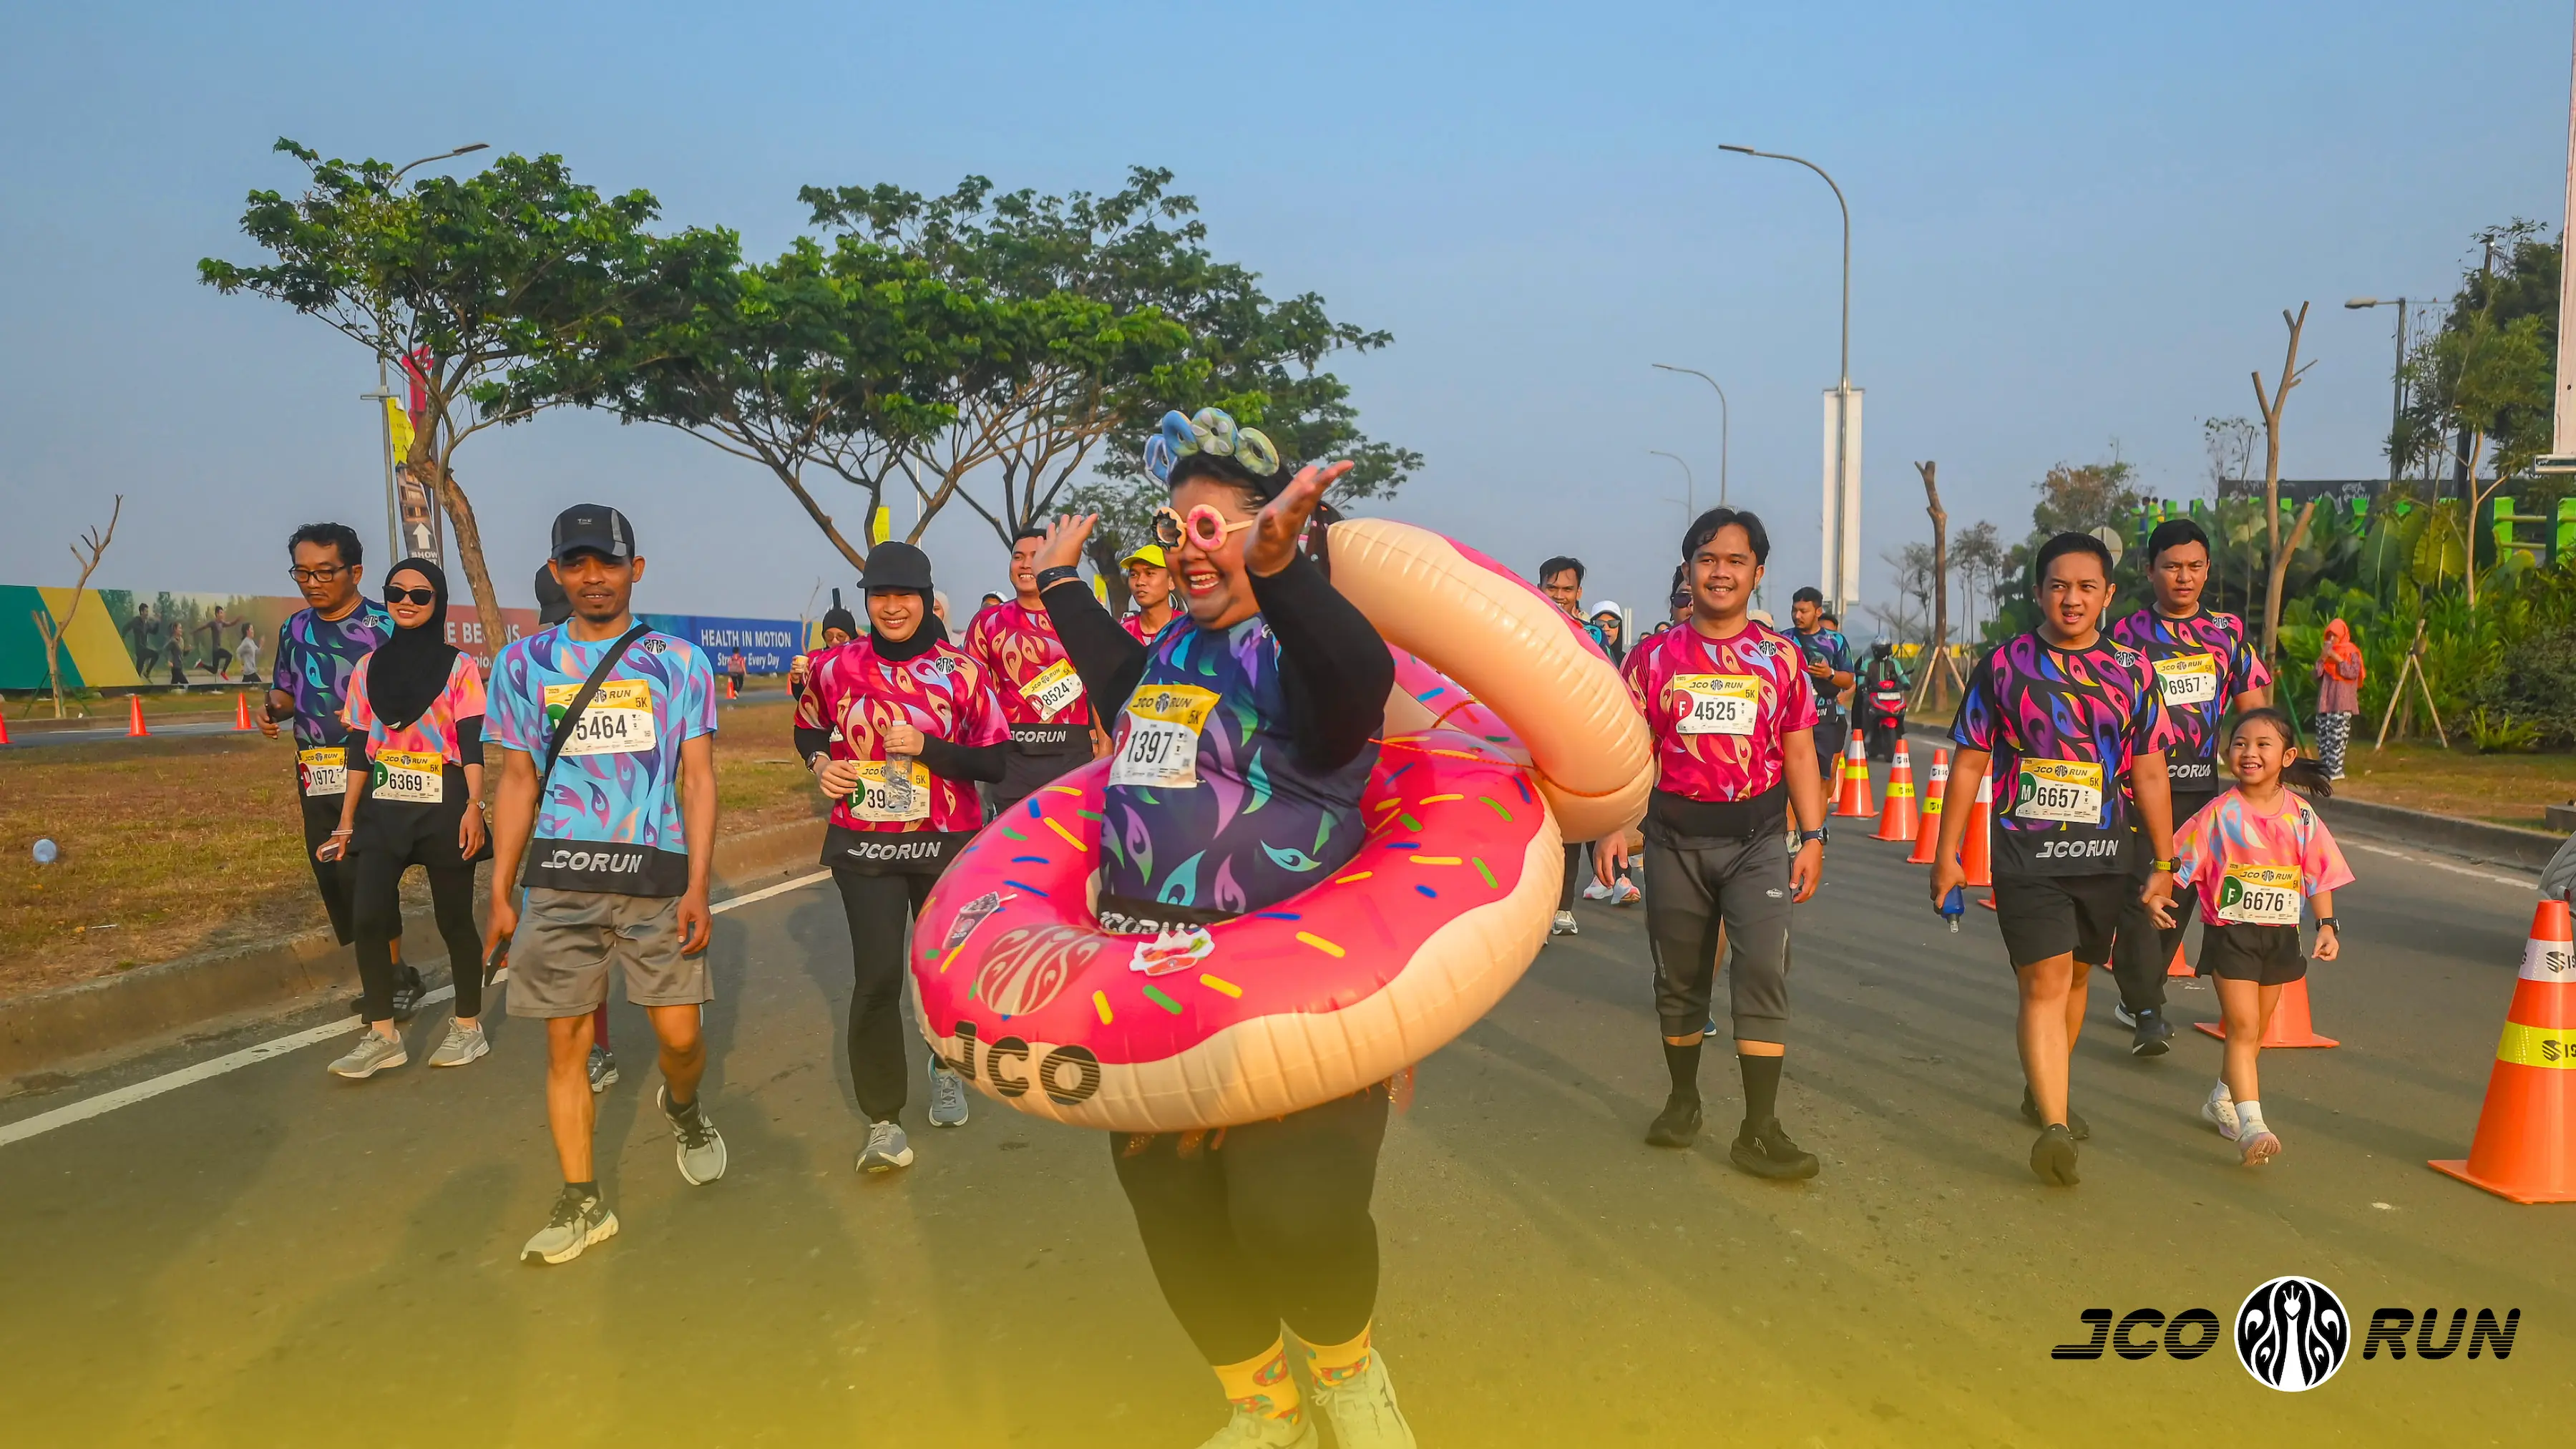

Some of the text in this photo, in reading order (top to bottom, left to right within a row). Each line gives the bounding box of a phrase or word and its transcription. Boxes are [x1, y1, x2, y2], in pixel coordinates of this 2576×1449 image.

[701, 629, 791, 648] HEALTH IN MOTION
[748, 653, 766, 670] Every
[768, 653, 779, 669] Day
[1031, 681, 1041, 692] JCO
[1048, 668, 1060, 678] RUN
[2169, 677, 2200, 695] 6957
[609, 690, 631, 699] RUN
[635, 697, 648, 708] 5K
[1042, 682, 1070, 706] 8524
[1169, 698, 1192, 708] RUN
[1745, 689, 1755, 698] 5K
[1187, 710, 1203, 725] 5K
[1679, 701, 1736, 721] F 4525
[576, 715, 628, 741] 5464
[1127, 731, 1174, 763] 1397
[313, 769, 336, 786] 1972
[377, 771, 422, 791] F 6369
[916, 775, 926, 784] 5K
[2089, 777, 2099, 786] 5K
[2021, 784, 2079, 809] M 6657
[847, 841, 942, 860] JCORUN
[2227, 888, 2285, 912] F 6676
[945, 1020, 1101, 1106] JCO
